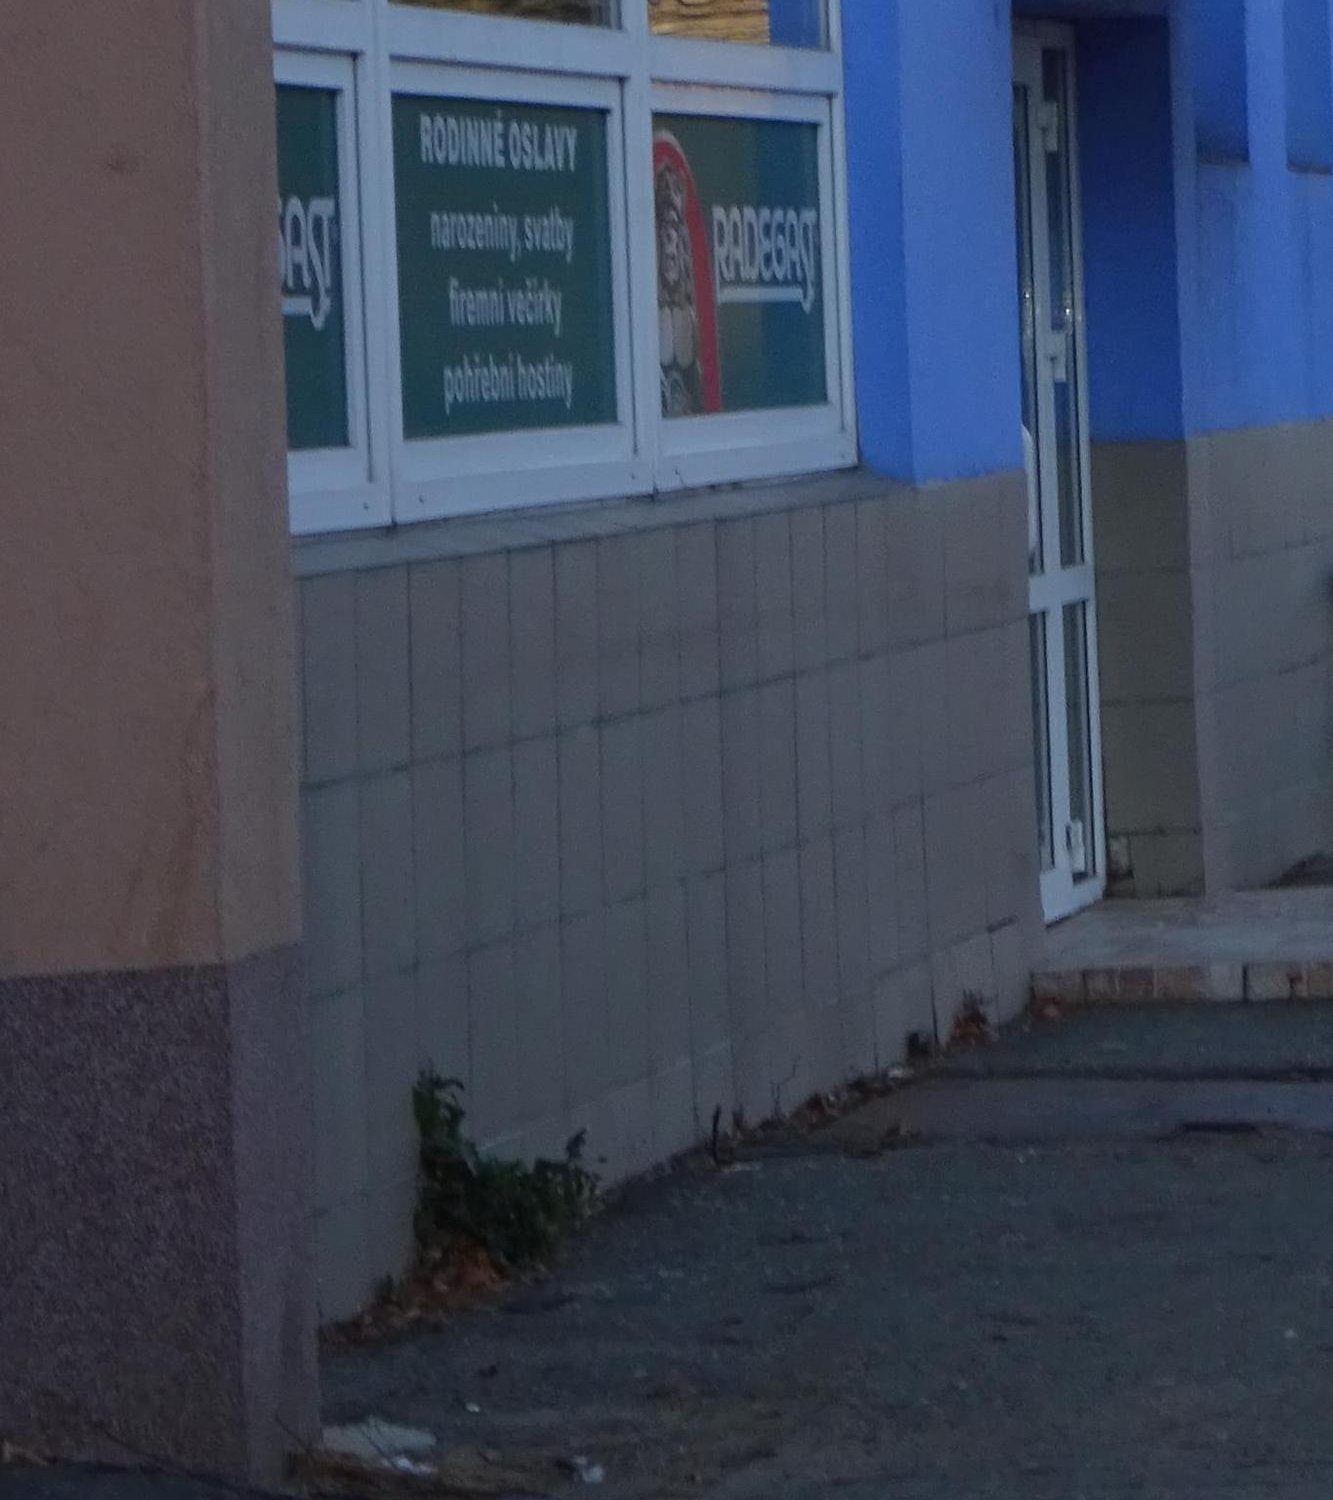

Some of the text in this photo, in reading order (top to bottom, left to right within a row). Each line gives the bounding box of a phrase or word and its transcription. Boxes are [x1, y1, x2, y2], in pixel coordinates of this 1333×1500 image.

[420, 109, 578, 172] RODINNÉ OSLAVY
[524, 203, 574, 264] svatby
[711, 204, 818, 314] RADEGAST
[515, 352, 574, 410] hostiny
